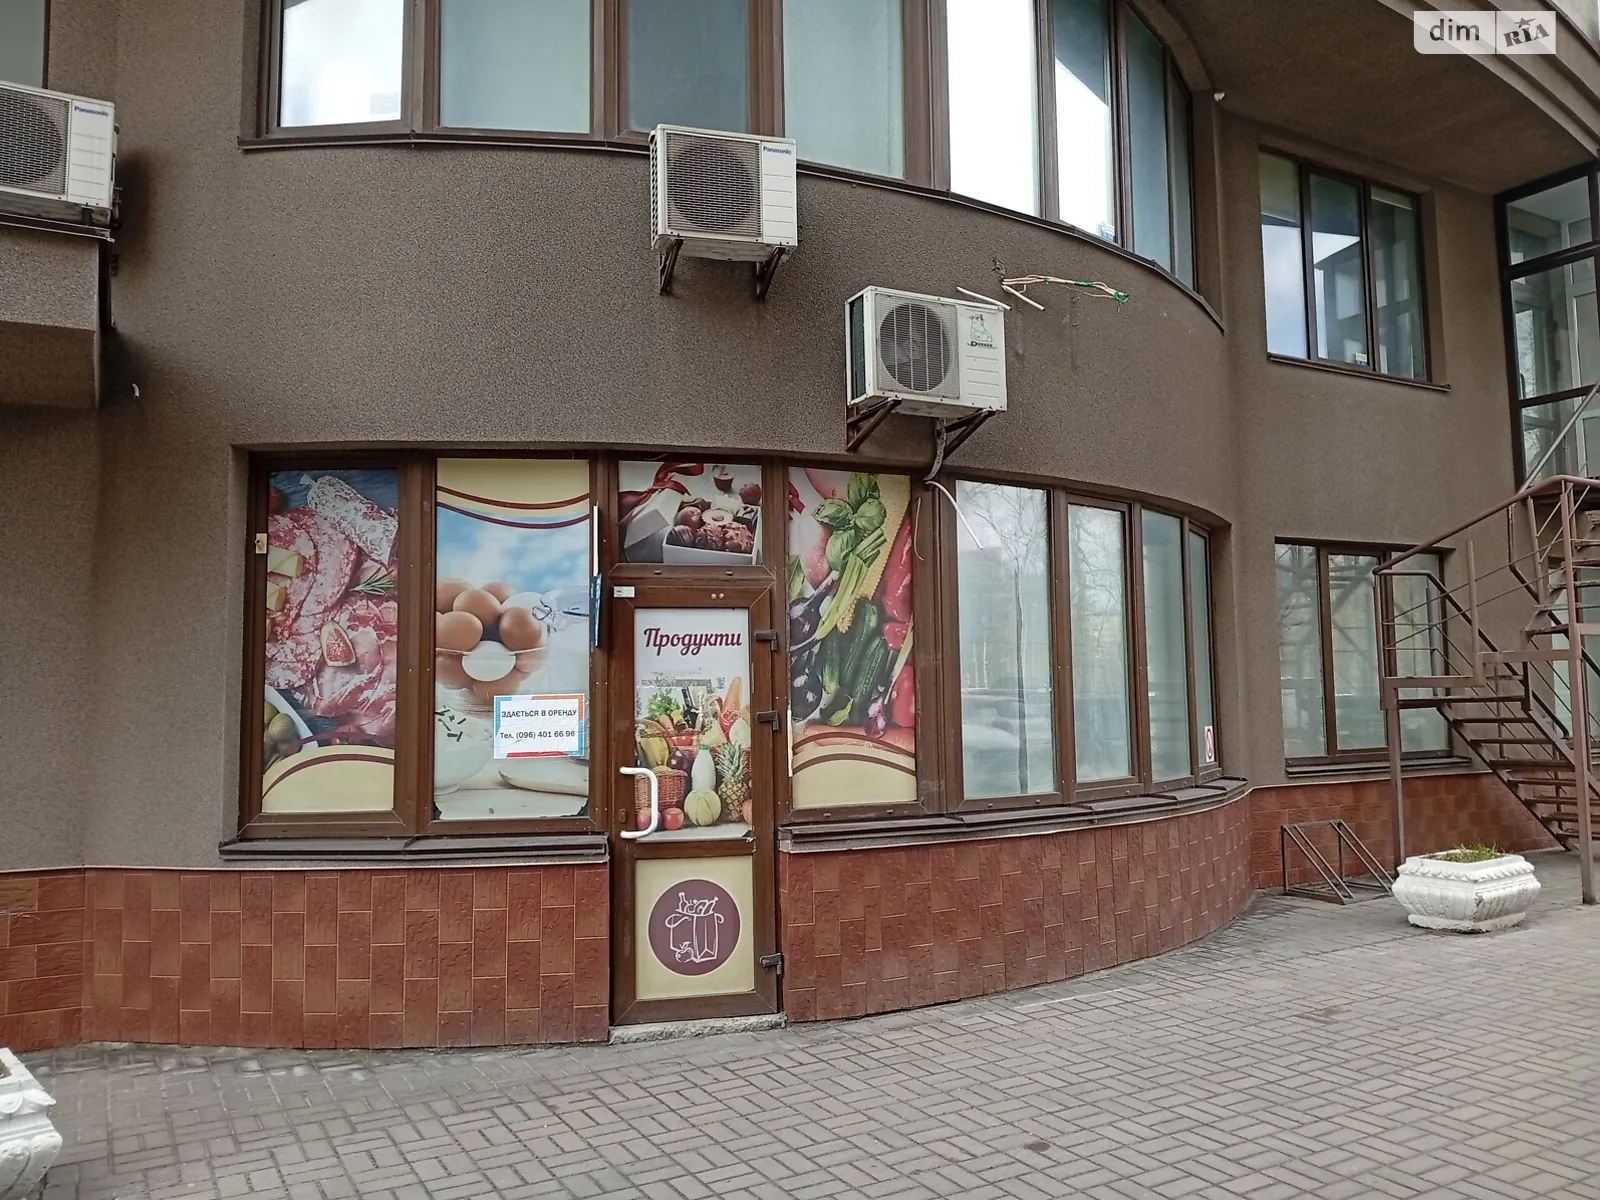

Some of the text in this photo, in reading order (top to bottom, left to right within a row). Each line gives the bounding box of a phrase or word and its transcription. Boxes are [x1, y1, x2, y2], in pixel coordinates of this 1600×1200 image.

[763, 146, 792, 155] Panasonic
[643, 627, 742, 656] Продукти
[501, 709, 577, 719] ЗДАЄТЬСЯ В ОРЕНДУ
[516, 731, 536, 739] (096)
[554, 730, 563, 738] 66
